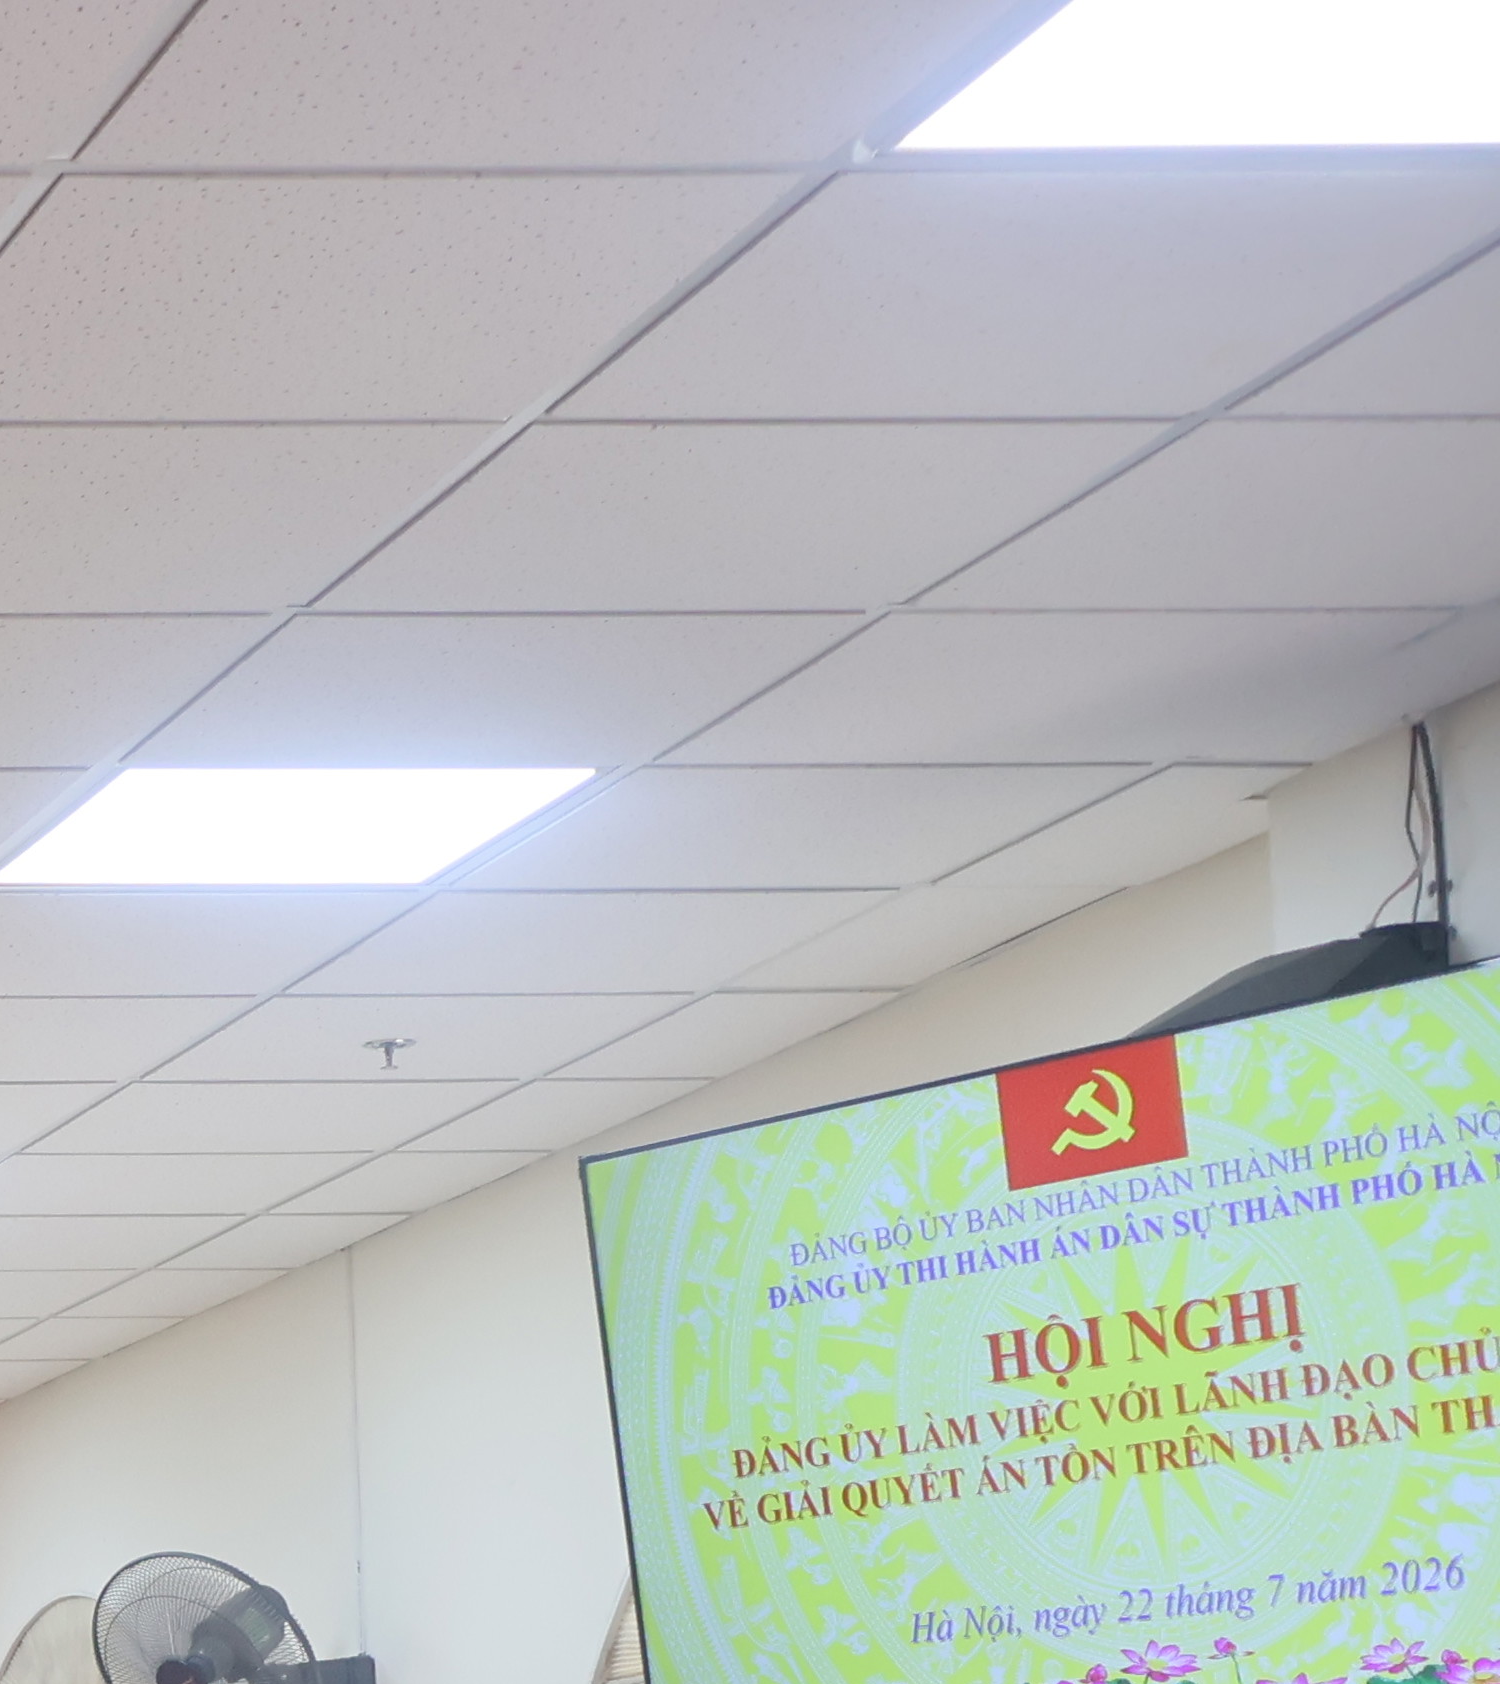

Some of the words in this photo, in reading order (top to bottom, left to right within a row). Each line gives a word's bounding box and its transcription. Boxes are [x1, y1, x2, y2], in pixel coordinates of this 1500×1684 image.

[983, 1314, 1107, 1386] HỘI
[1122, 1284, 1305, 1361] NGHỊ
[910, 1609, 954, 1644] Hà
[963, 1605, 1022, 1643] Nội,
[1034, 1595, 1107, 1638] ngày
[1117, 1587, 1153, 1624] 22
[1165, 1581, 1255, 1620] tháng
[1267, 1573, 1285, 1606] 7
[1297, 1571, 1366, 1605] năm
[1380, 1553, 1465, 1597] 2026
